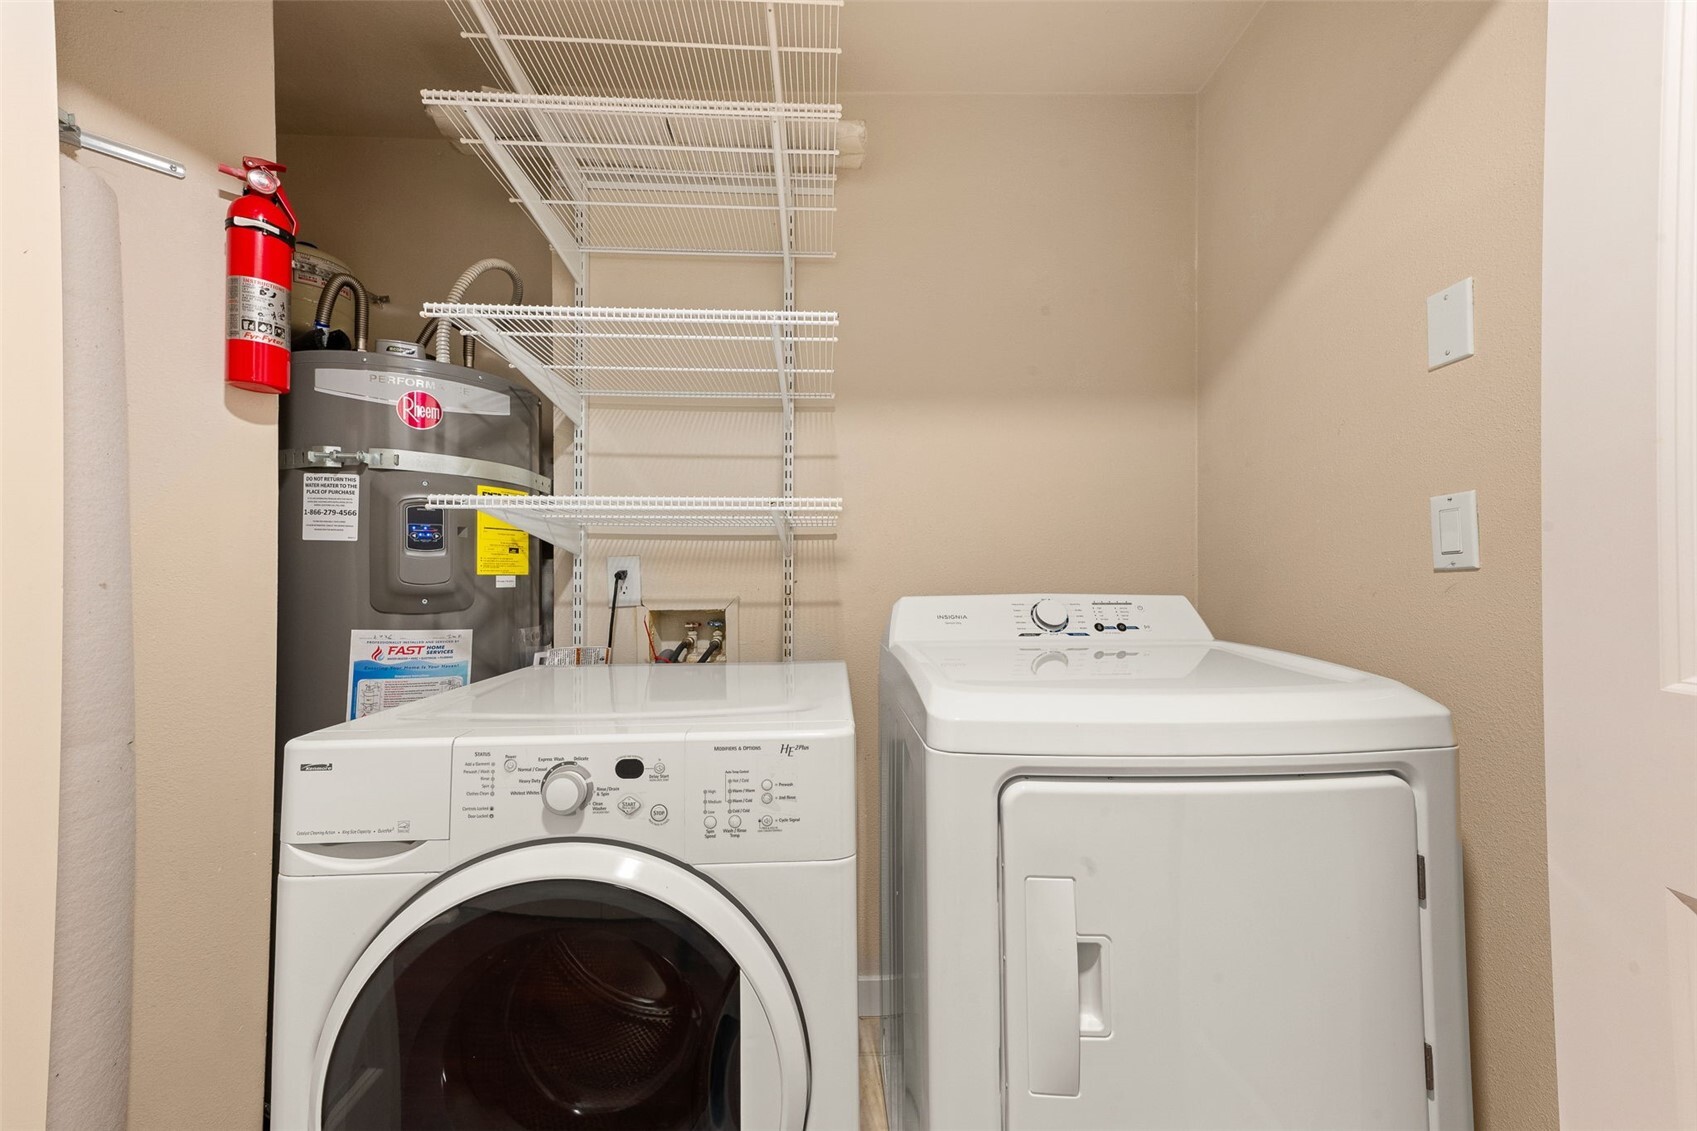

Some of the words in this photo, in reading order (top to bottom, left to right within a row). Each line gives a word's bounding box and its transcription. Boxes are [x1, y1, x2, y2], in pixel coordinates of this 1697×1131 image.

[244, 332, 284, 345] Fyr-Fyter
[403, 391, 440, 423] Rheem
[388, 646, 425, 655] FAST
